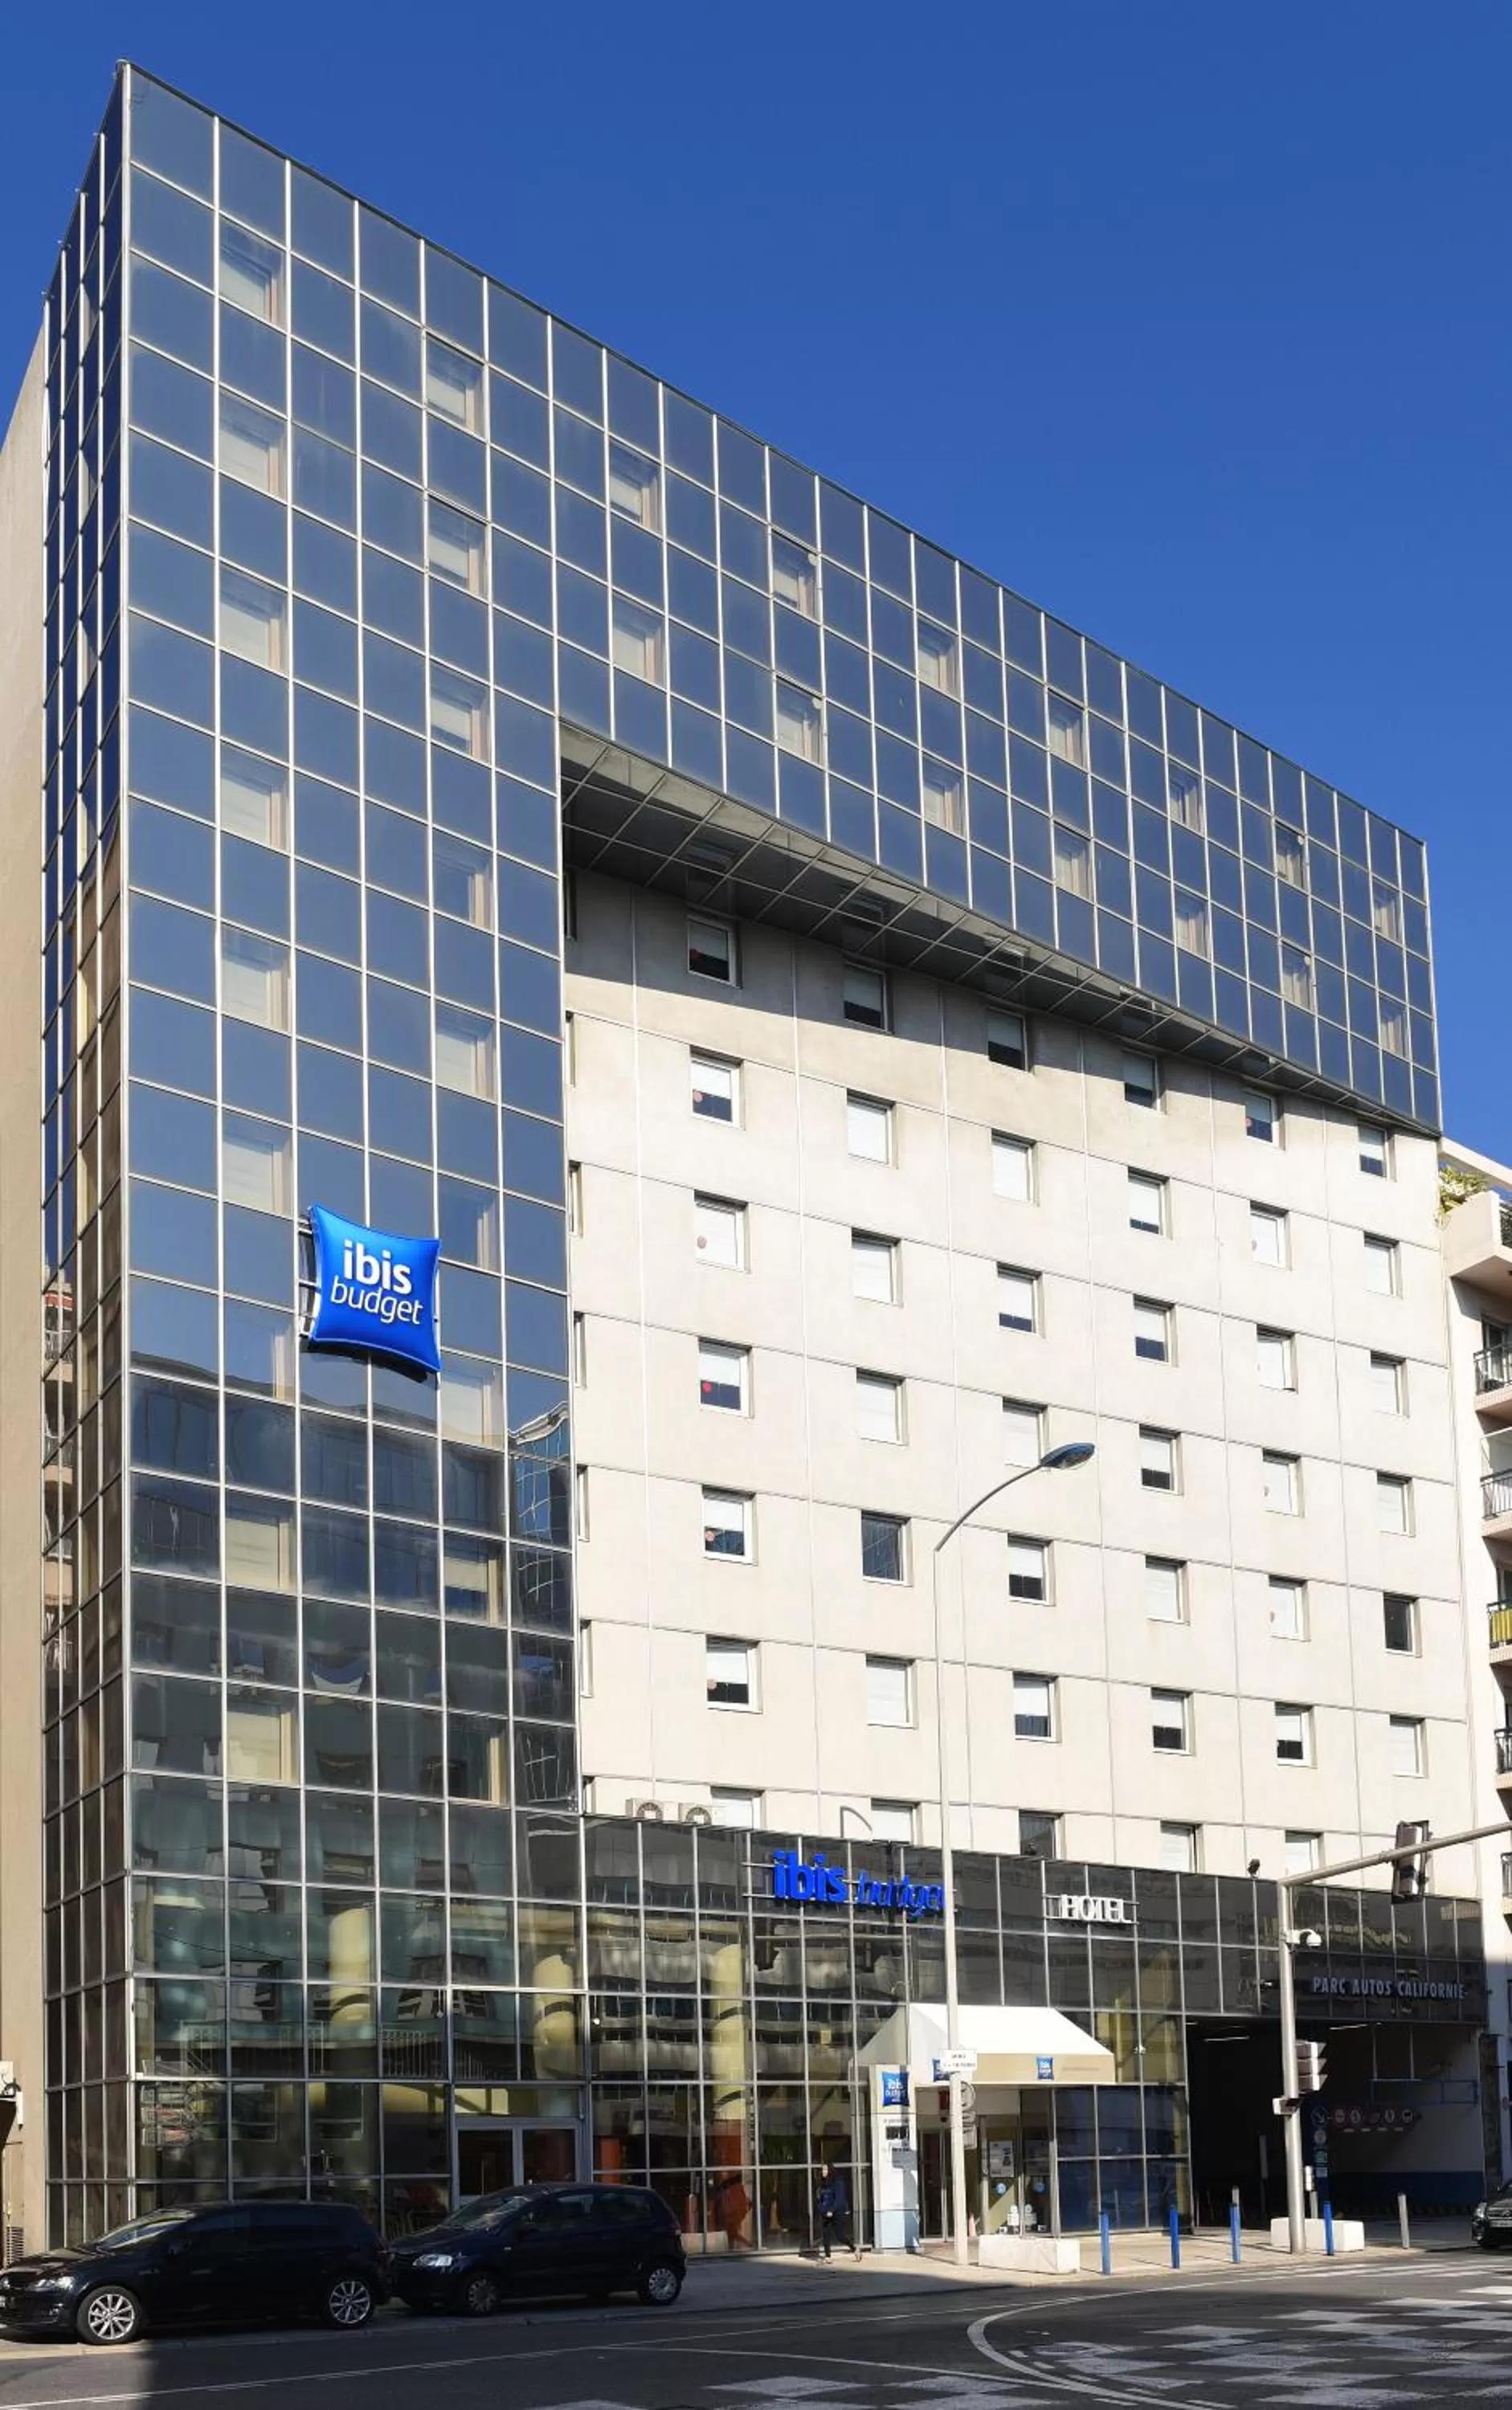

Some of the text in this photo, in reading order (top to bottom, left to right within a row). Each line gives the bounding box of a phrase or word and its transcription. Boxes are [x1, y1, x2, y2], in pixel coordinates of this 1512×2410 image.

[343, 1239, 412, 1295] ibis
[330, 1275, 423, 1325] budget
[772, 1850, 946, 1916] ibis budge
[1061, 1894, 1132, 1924] HOTEL
[1314, 1976, 1465, 1999] PARC AUTOS CALIFORNIE
